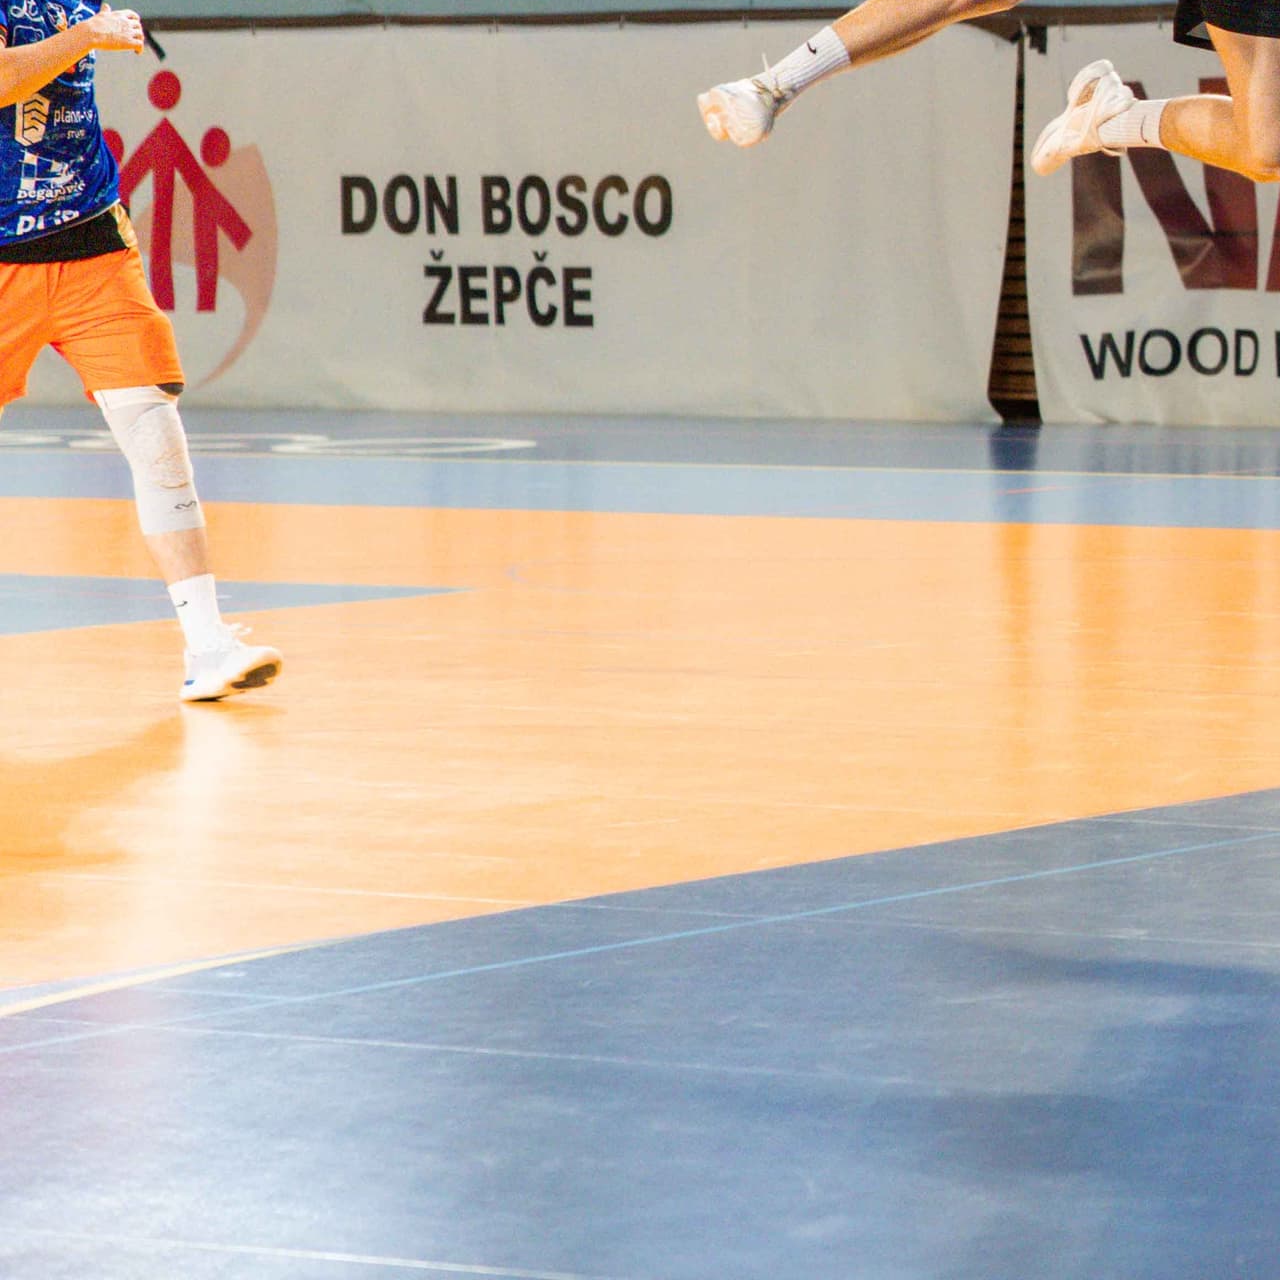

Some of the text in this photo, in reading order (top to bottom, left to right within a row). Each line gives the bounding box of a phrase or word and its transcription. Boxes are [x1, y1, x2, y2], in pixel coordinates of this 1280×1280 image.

[340, 174, 674, 238] DON BOSCO
[422, 250, 595, 328] ŽEPČE
[1080, 326, 1260, 383] WOOD
